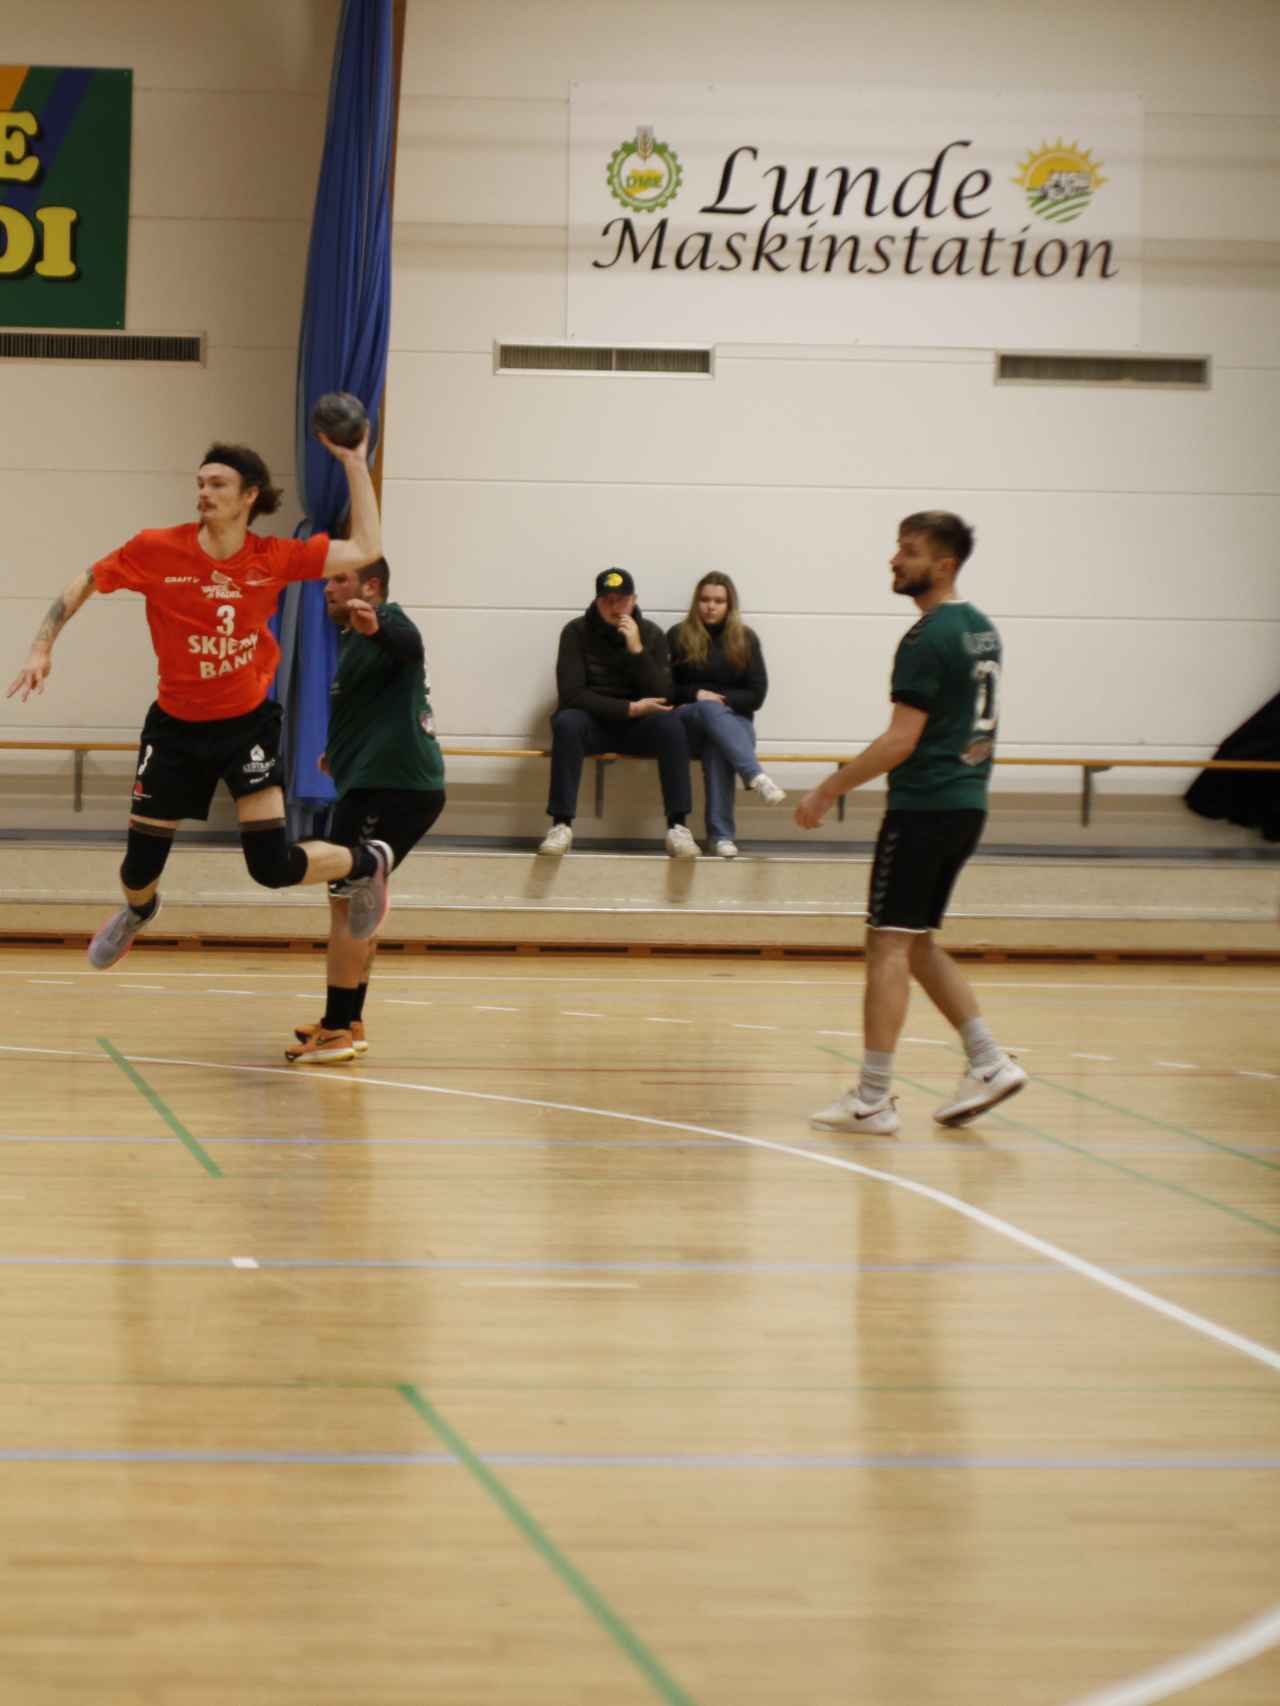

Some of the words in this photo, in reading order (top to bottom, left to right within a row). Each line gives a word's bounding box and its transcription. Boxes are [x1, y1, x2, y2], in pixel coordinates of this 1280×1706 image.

[698, 139, 992, 219] Lunde
[592, 217, 1119, 279] Maskinstation
[216, 604, 236, 636] 3
